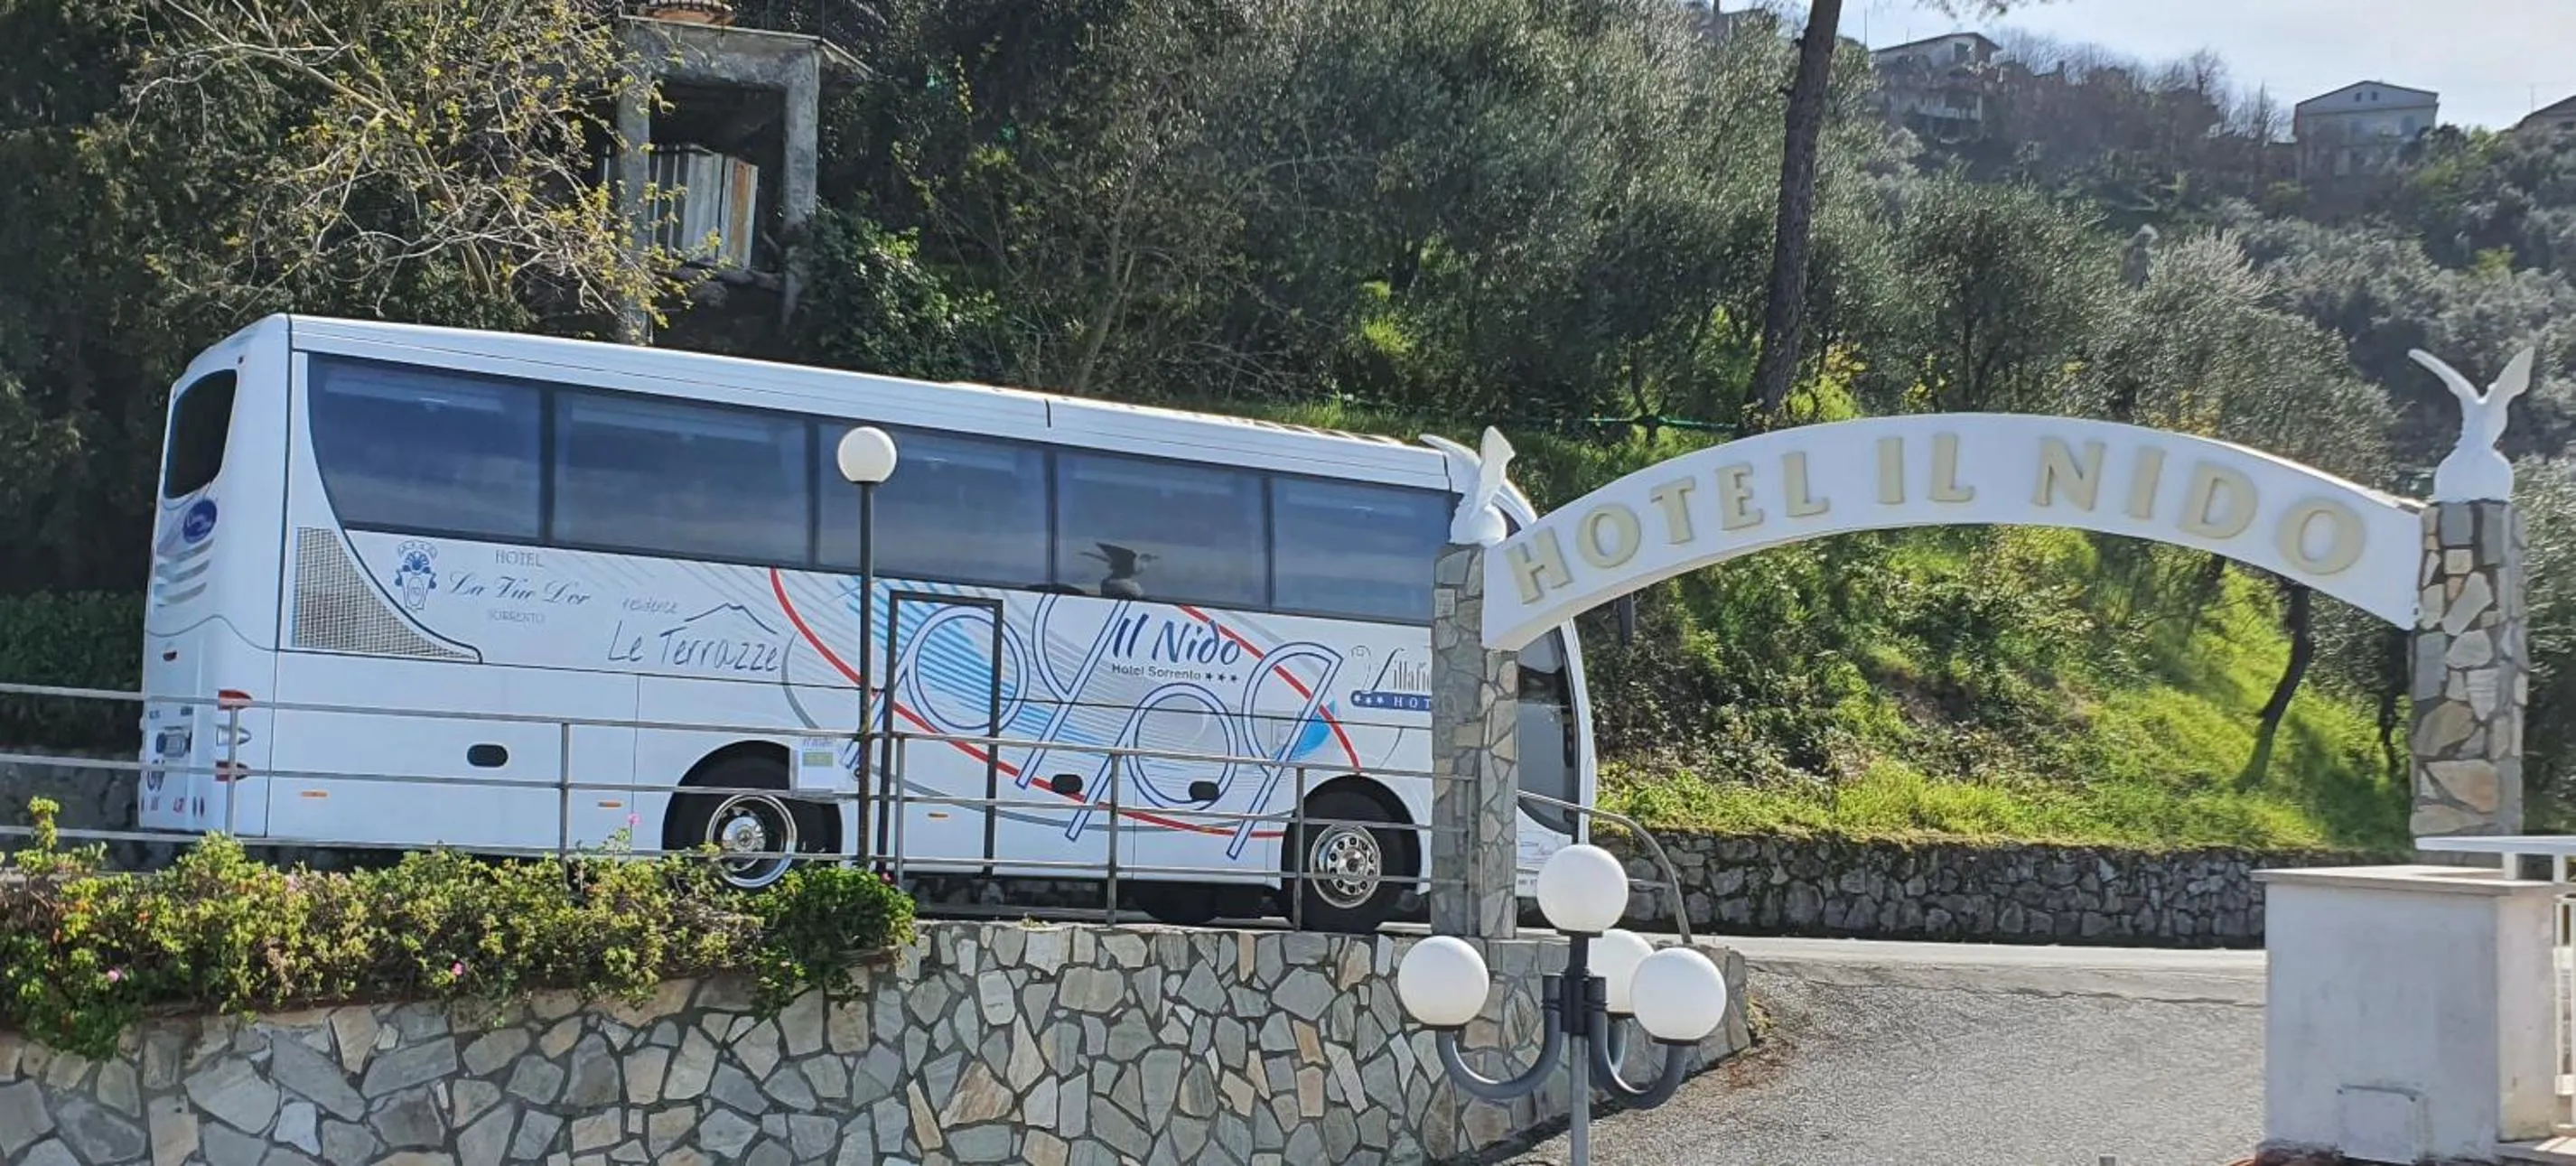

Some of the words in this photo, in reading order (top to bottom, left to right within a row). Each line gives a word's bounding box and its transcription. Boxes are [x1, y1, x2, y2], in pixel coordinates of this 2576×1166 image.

[1503, 450, 1830, 604] HOTEL
[1876, 434, 1975, 505] IL
[2031, 434, 2367, 576] NIDO
[495, 549, 545, 568] HOTEL
[449, 571, 486, 597] La
[608, 620, 644, 663] Le
[659, 626, 779, 672] Terrazze
[1112, 612, 1150, 659] Il
[1152, 619, 1241, 666] Nido
[1111, 662, 1144, 677] Hotel
[1147, 665, 1202, 681] Sorrento
